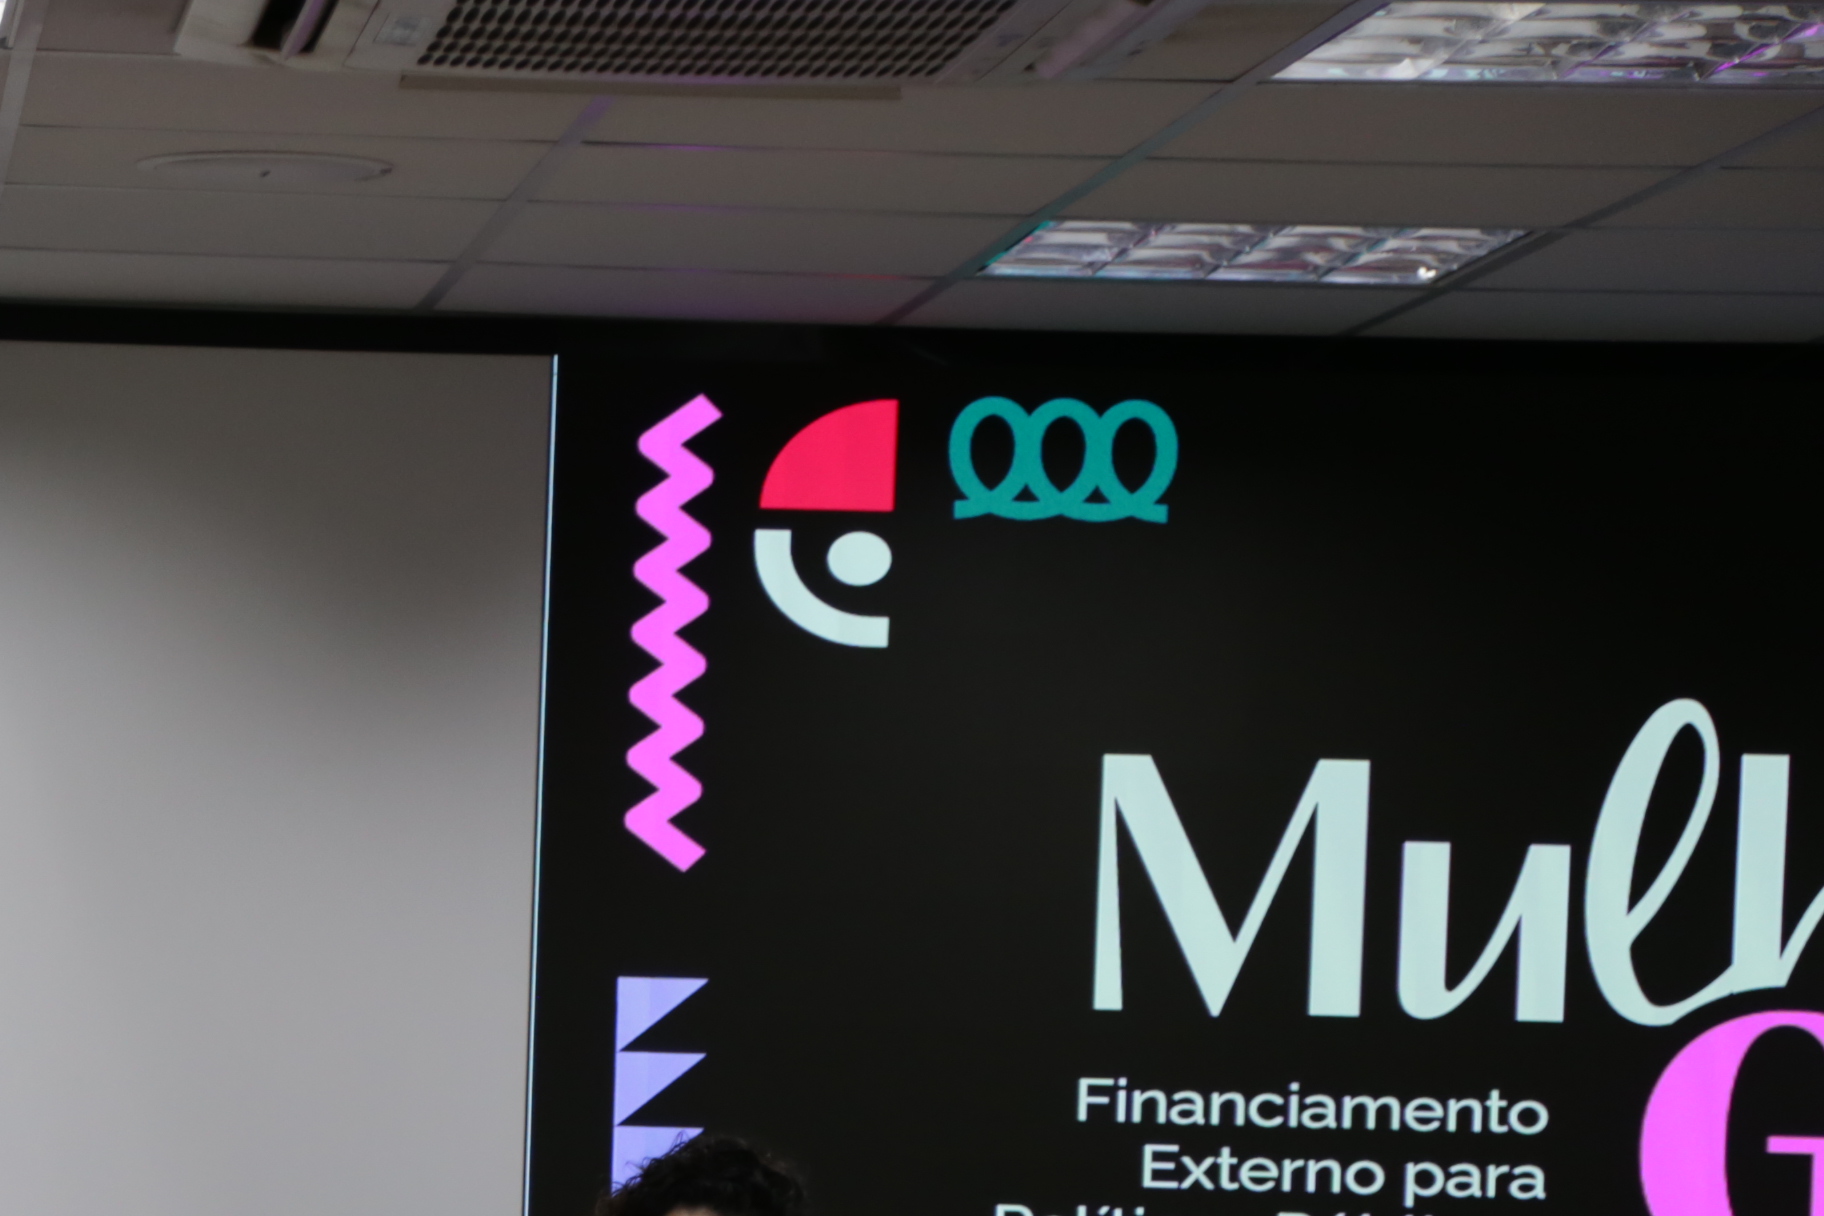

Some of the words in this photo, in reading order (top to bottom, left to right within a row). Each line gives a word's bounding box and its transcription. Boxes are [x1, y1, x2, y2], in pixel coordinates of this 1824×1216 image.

[1076, 1077, 1549, 1136] Financiamento
[1141, 1144, 1385, 1195] Externo
[1405, 1161, 1546, 1207] para
